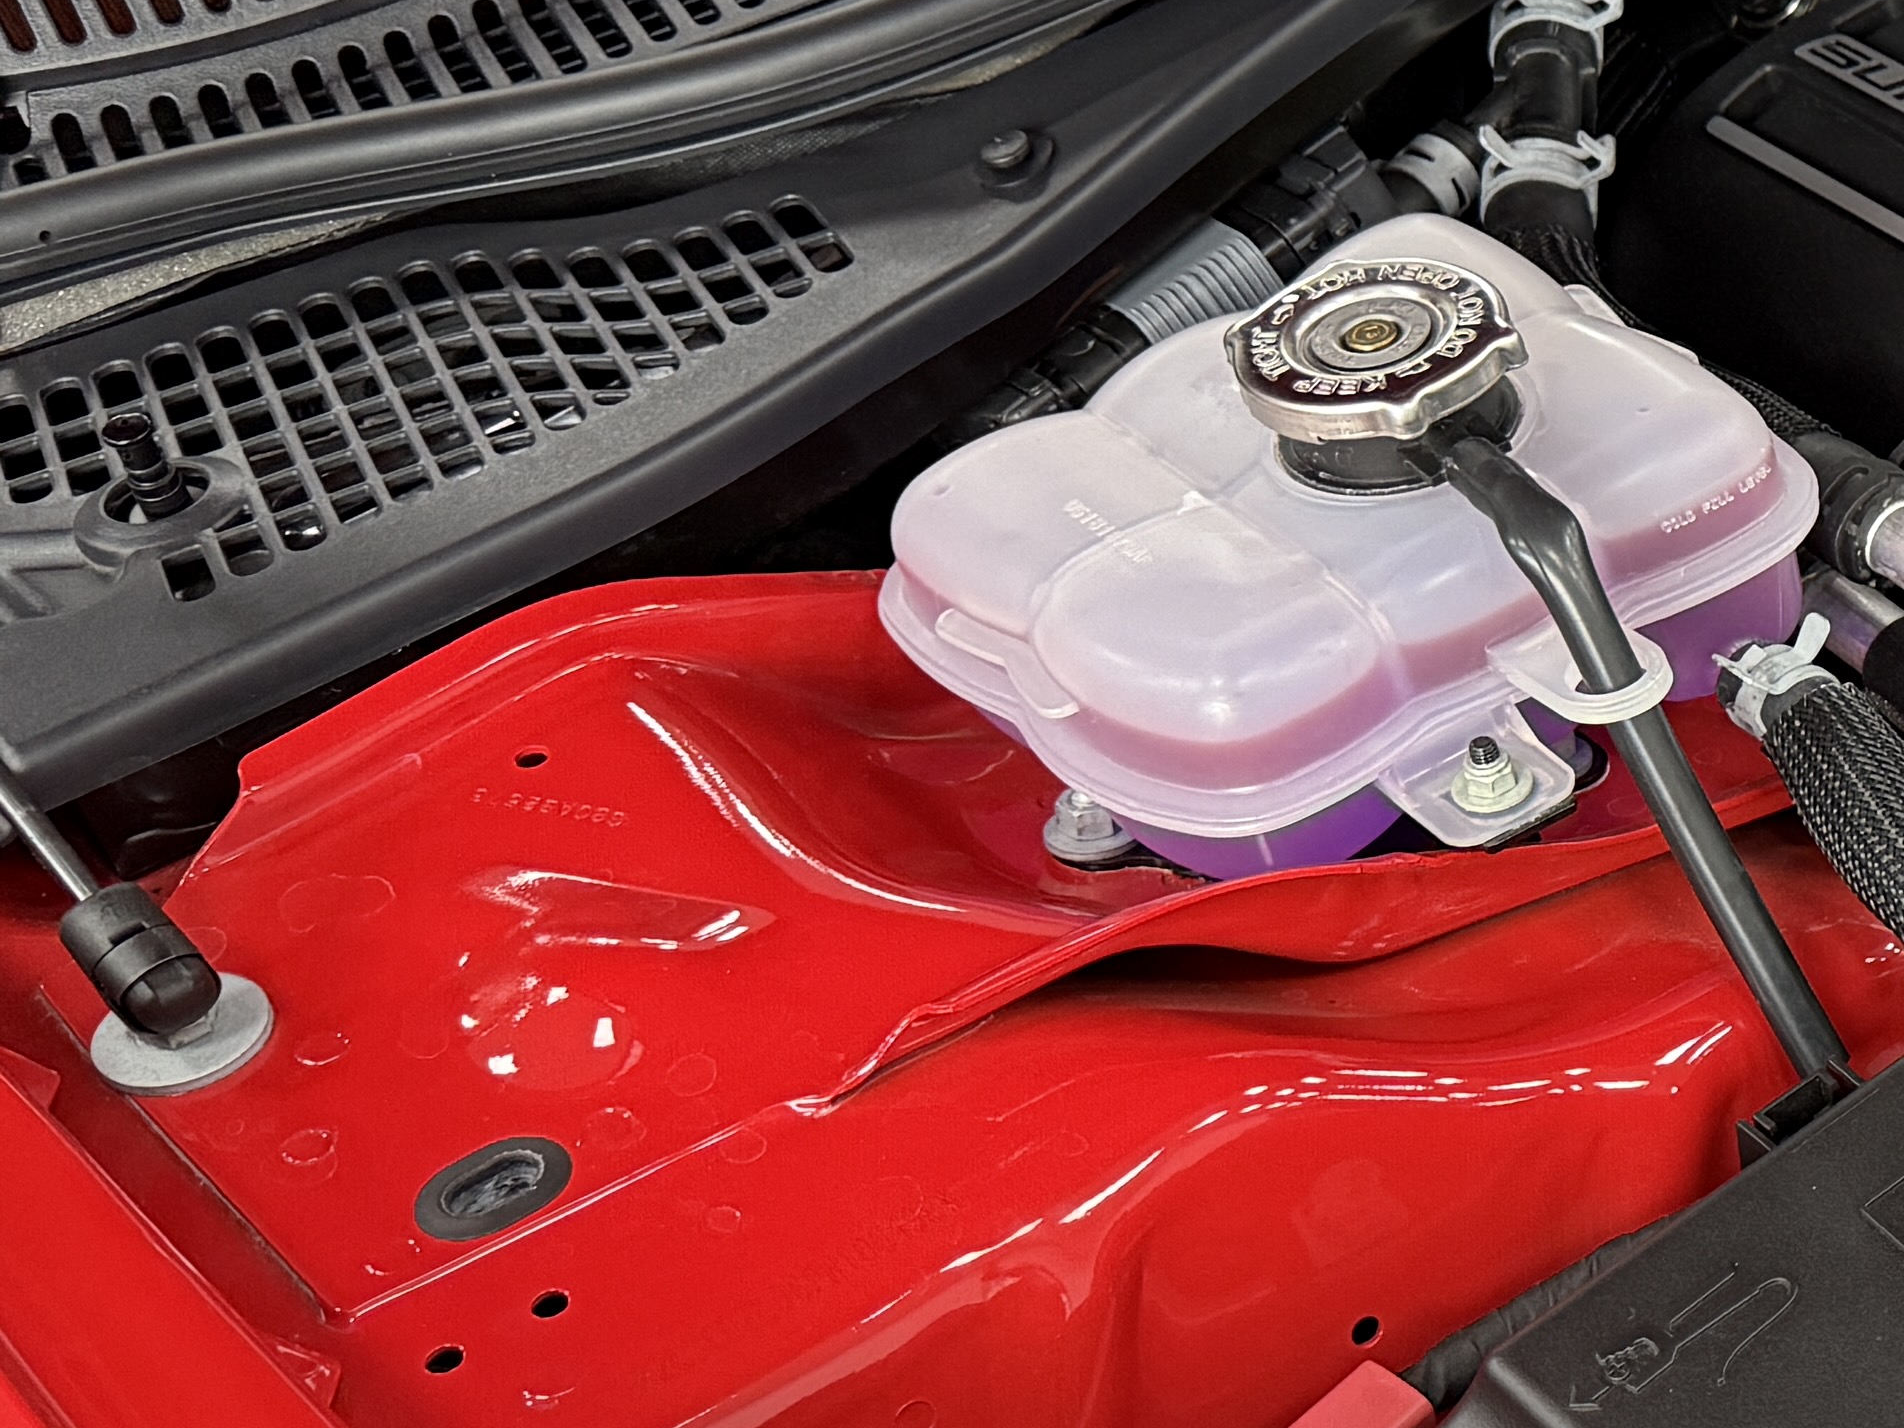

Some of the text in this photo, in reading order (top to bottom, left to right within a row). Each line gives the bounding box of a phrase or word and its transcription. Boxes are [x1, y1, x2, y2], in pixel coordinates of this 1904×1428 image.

[1301, 268, 1366, 300] HOT
[1377, 264, 1460, 291] OPEN
[1292, 374, 1388, 396] KEEP
[1701, 491, 1735, 514] FILL
